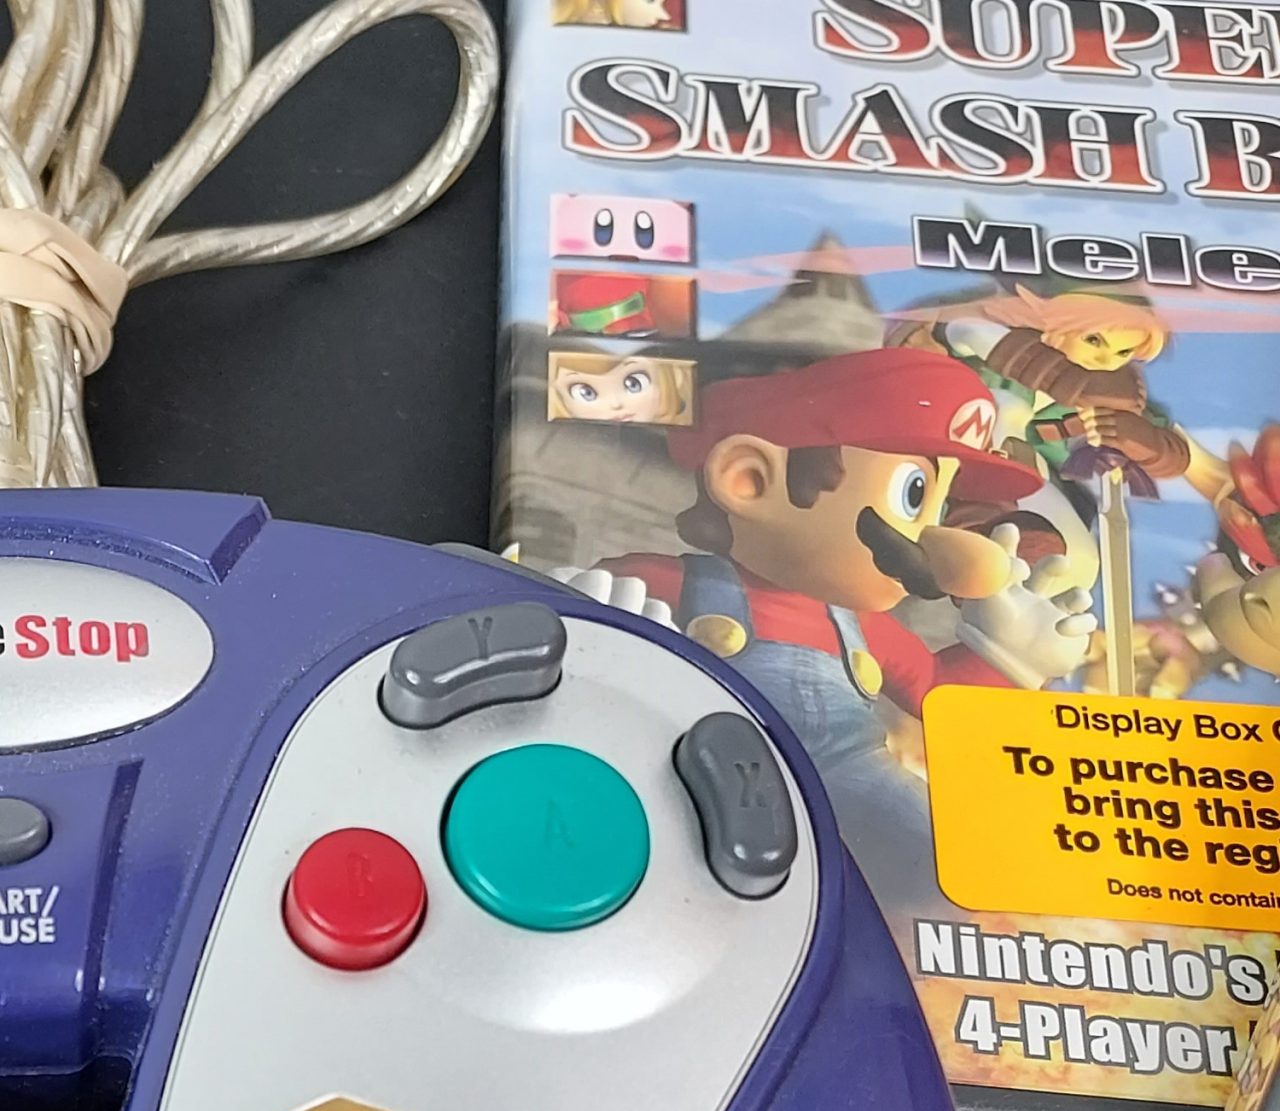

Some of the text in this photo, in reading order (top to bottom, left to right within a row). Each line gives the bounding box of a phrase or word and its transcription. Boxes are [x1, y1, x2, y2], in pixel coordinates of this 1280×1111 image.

[813, 0, 1280, 83] SUPE
[562, 58, 1166, 195] SMASH
[912, 214, 1280, 291] Mele
[467, 616, 493, 660] Y
[1055, 704, 1183, 742] Display
[1193, 713, 1264, 743] Box
[733, 761, 768, 808] X
[1003, 745, 1275, 793] To purchase
[1063, 786, 1280, 831] bring this
[1053, 823, 1280, 875] to the reg
[1107, 877, 1163, 899] Does
[1168, 887, 1204, 904] not
[915, 918, 1268, 1006] Nintendo's
[955, 993, 1237, 1077] 4-Player
